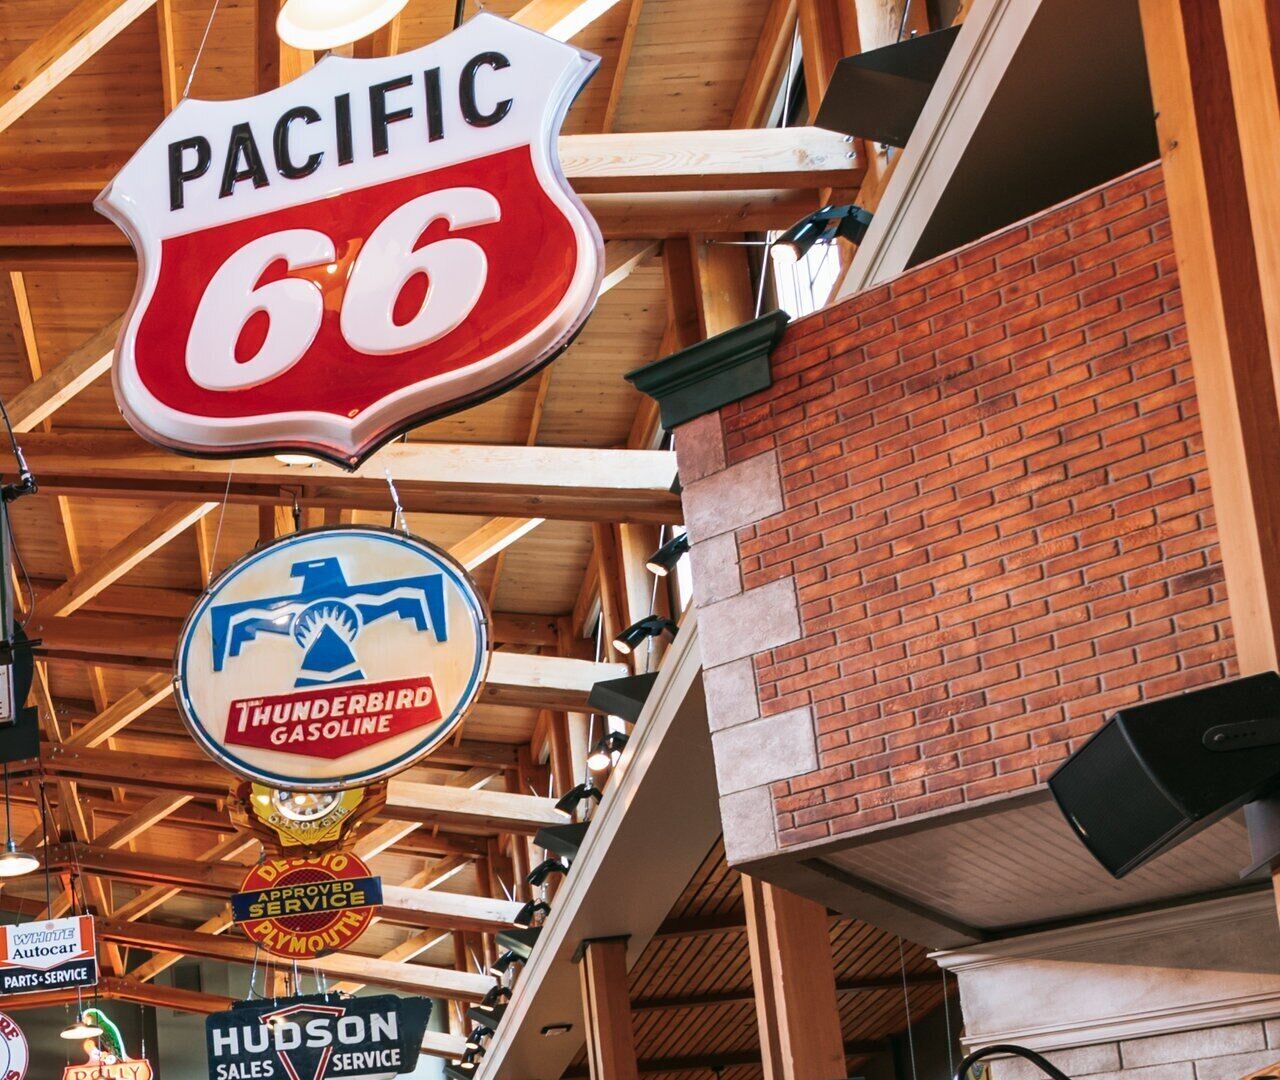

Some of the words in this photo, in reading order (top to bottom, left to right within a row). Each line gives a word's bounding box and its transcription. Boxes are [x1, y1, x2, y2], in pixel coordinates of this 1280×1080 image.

[167, 51, 514, 211] PACIFIC
[185, 186, 501, 392] 66
[236, 686, 434, 732] THUNDERBIRD
[269, 714, 393, 745] GASOLINE
[248, 890, 366, 918] SERVICE
[257, 880, 355, 903] APPROVED
[253, 909, 364, 954] PLYMOUTH
[12, 943, 77, 960] Autocar
[4, 973, 38, 988] PARTS
[44, 967, 88, 985] SERVICE
[212, 1010, 399, 1057] HUDSON
[332, 1048, 402, 1072] SERVICE
